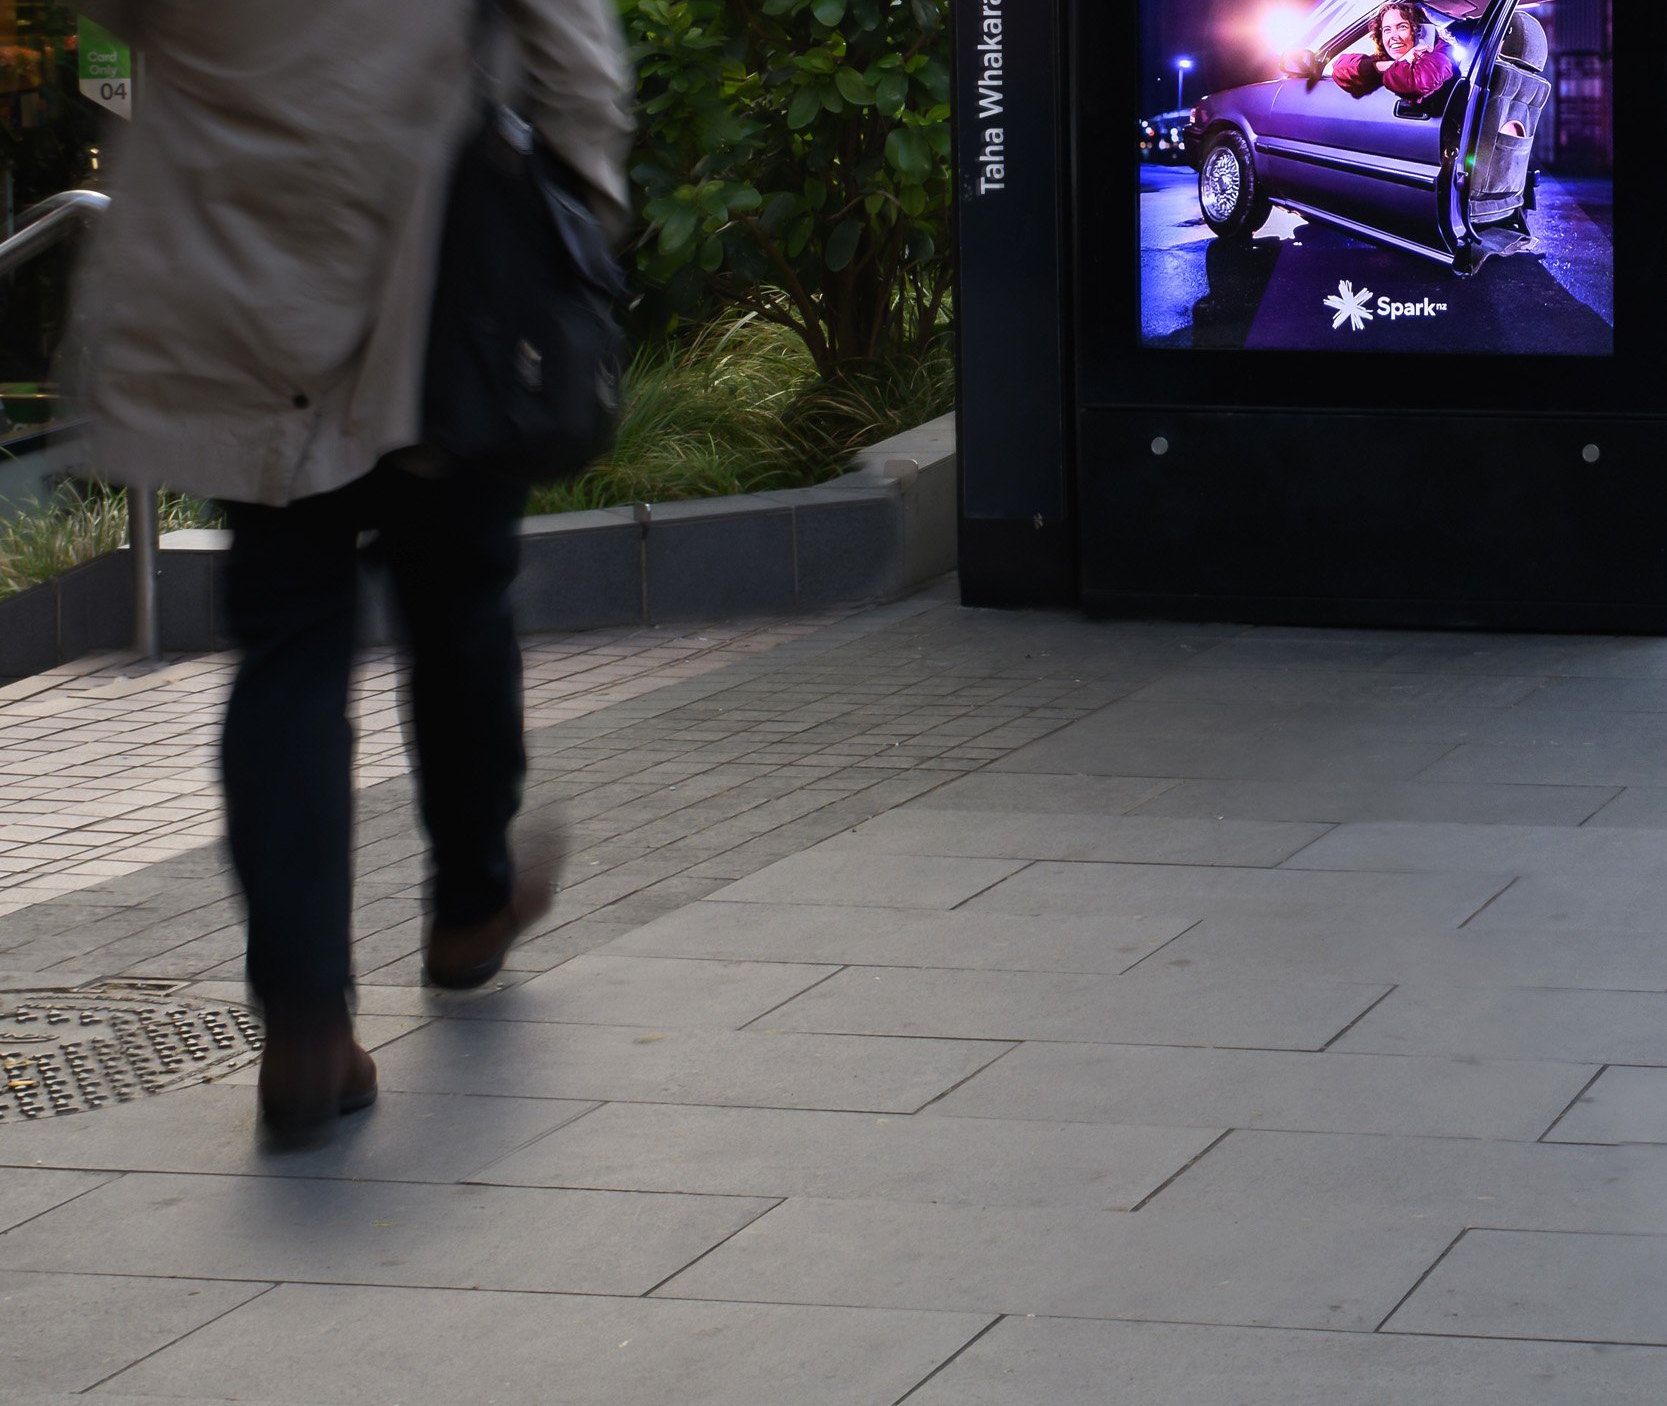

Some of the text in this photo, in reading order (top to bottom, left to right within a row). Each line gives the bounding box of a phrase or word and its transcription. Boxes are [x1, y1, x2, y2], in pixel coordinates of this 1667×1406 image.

[87, 50, 118, 63] Card
[89, 64, 119, 78] Only
[100, 82, 127, 101] 04
[980, 127, 1006, 196] Taha
[1376, 296, 1436, 320] Spark
